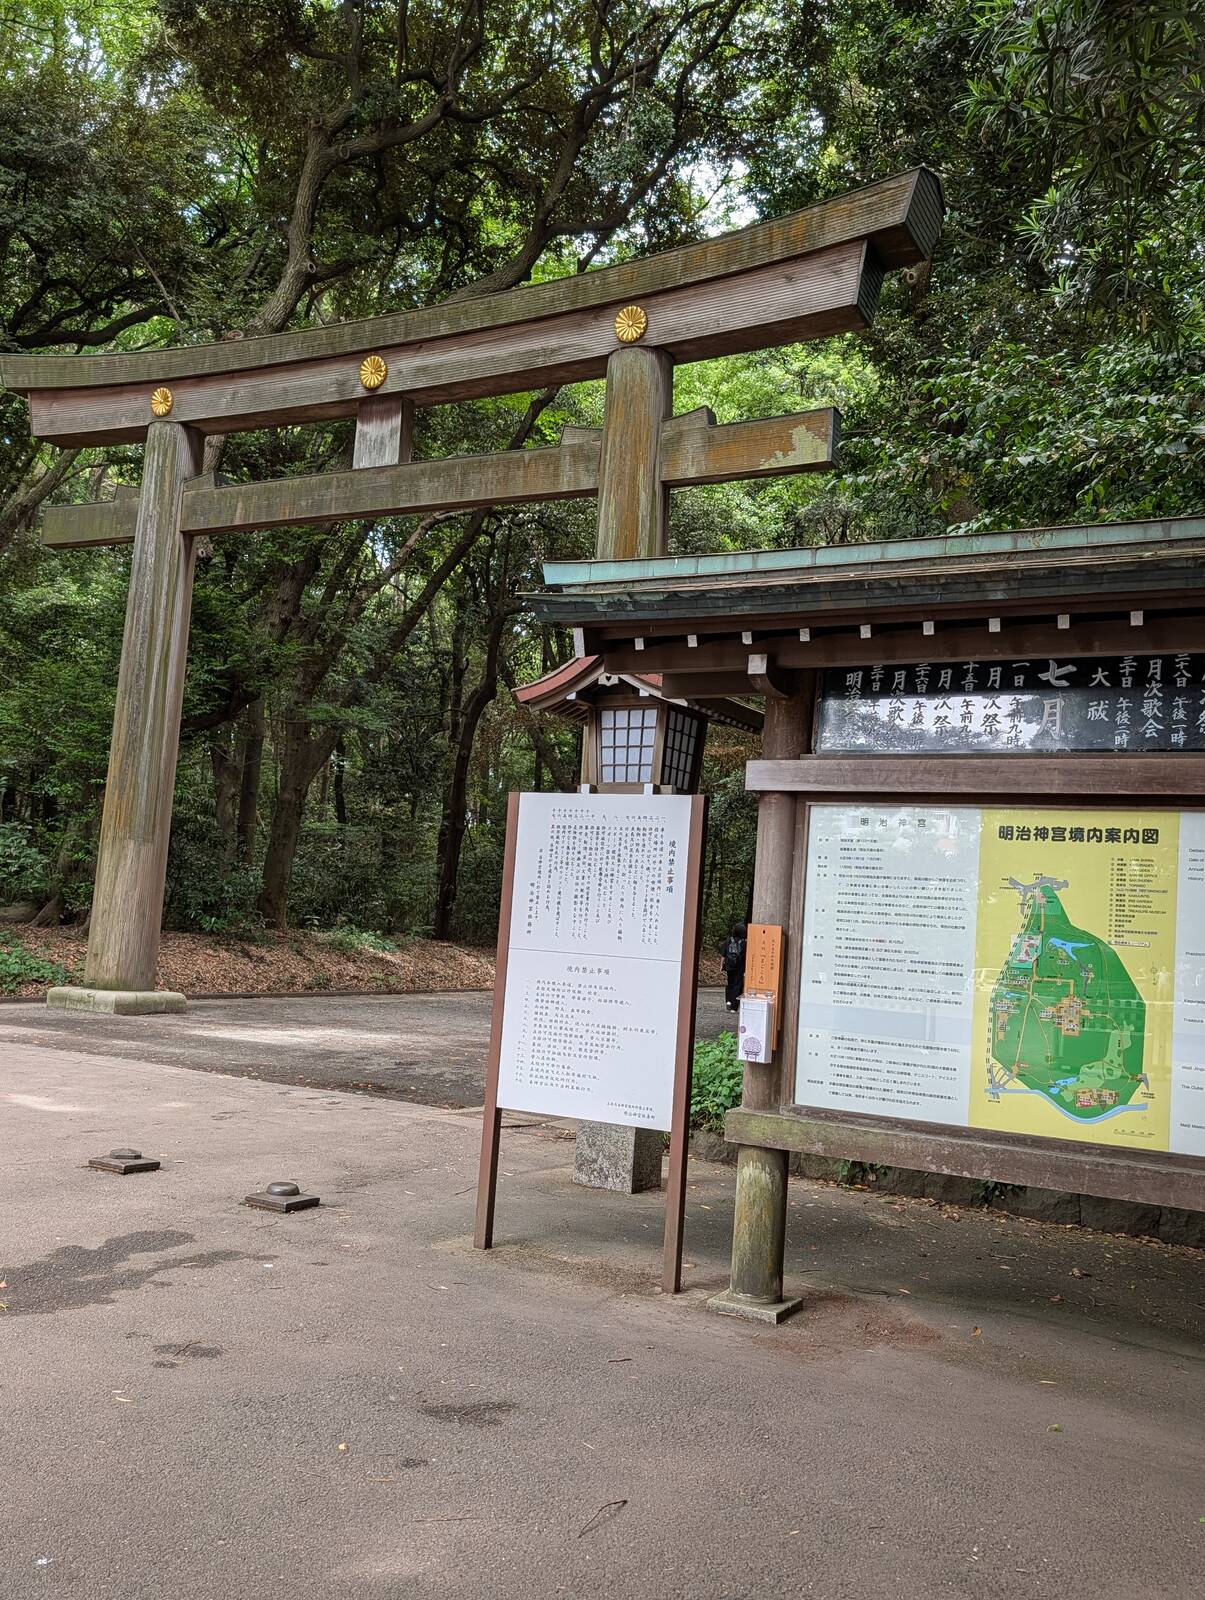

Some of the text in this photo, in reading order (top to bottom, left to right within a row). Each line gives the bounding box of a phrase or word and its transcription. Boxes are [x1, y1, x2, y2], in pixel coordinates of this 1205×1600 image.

[871, 664, 885, 692] 三十日
[914, 663, 931, 693] 二十六日
[961, 661, 979, 692] 十五日
[980, 666, 1003, 736] 月次祭
[1012, 662, 1030, 687] 一日
[1037, 659, 1077, 740] 七月
[1087, 667, 1111, 721] 大祓
[1140, 659, 1164, 738] 月次歌会
[1171, 654, 1192, 747] 二十八日 午後一時
[932, 668, 952, 736] 月次祭
[1114, 656, 1137, 748] 三十日 午後二時
[860, 817, 927, 828] 明治神宮
[998, 825, 1160, 845] 明治神宮境内案内図
[665, 840, 676, 894] 境内禁止事項
